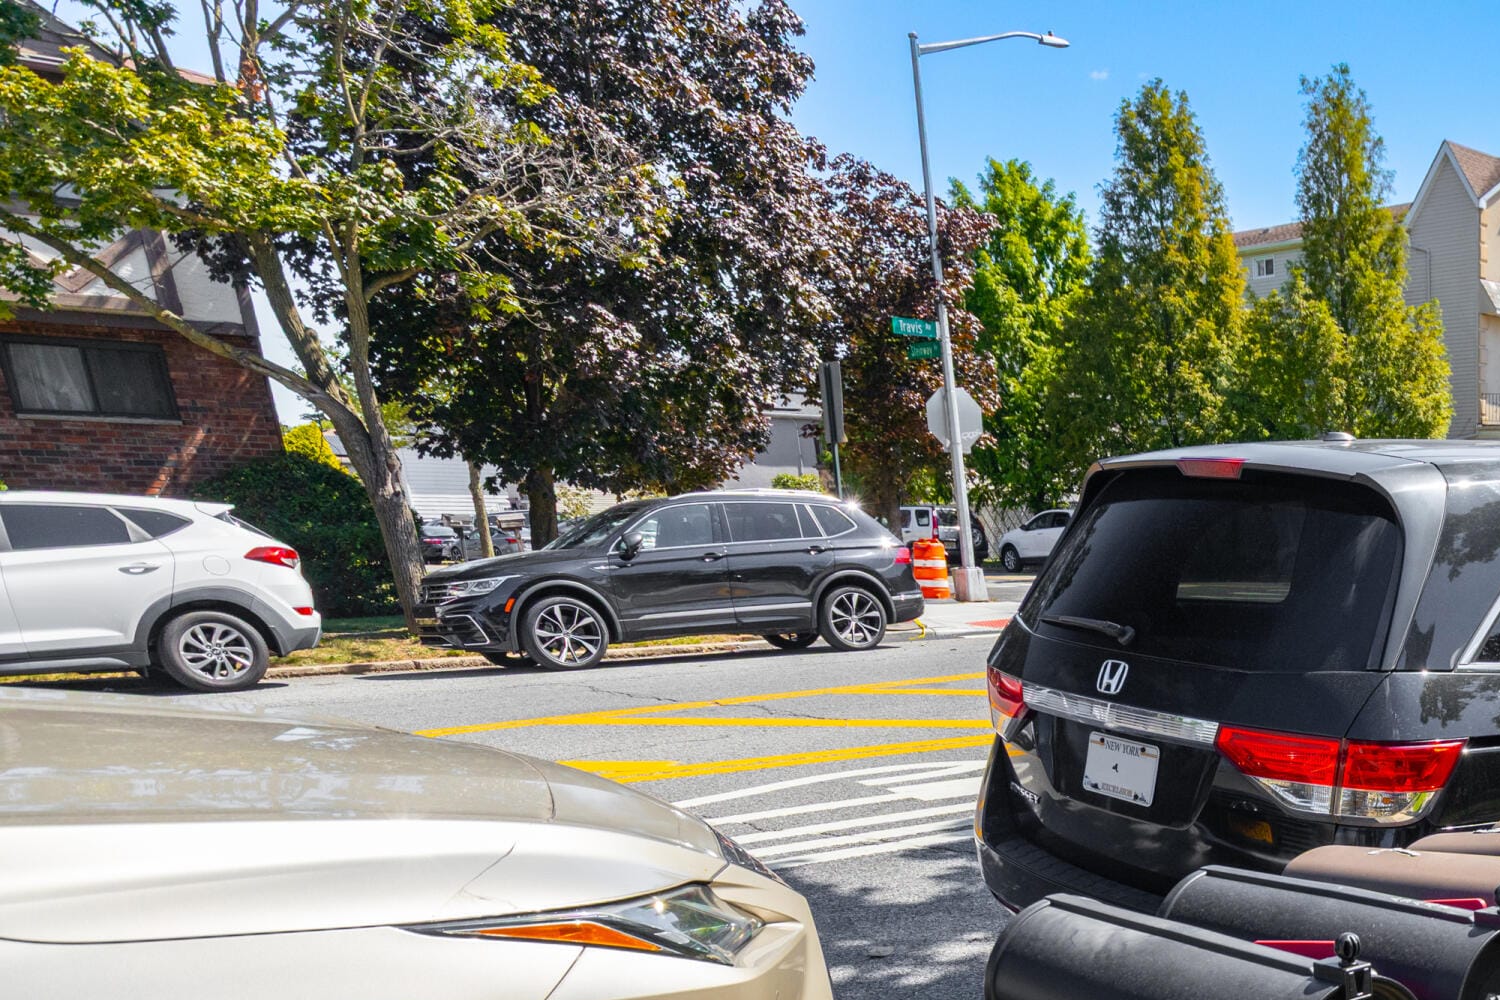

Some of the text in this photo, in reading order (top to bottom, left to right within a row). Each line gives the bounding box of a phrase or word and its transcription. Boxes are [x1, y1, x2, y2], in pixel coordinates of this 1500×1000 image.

[897, 319, 923, 335] Travis
[1105, 739, 1140, 758] NEW YORK
